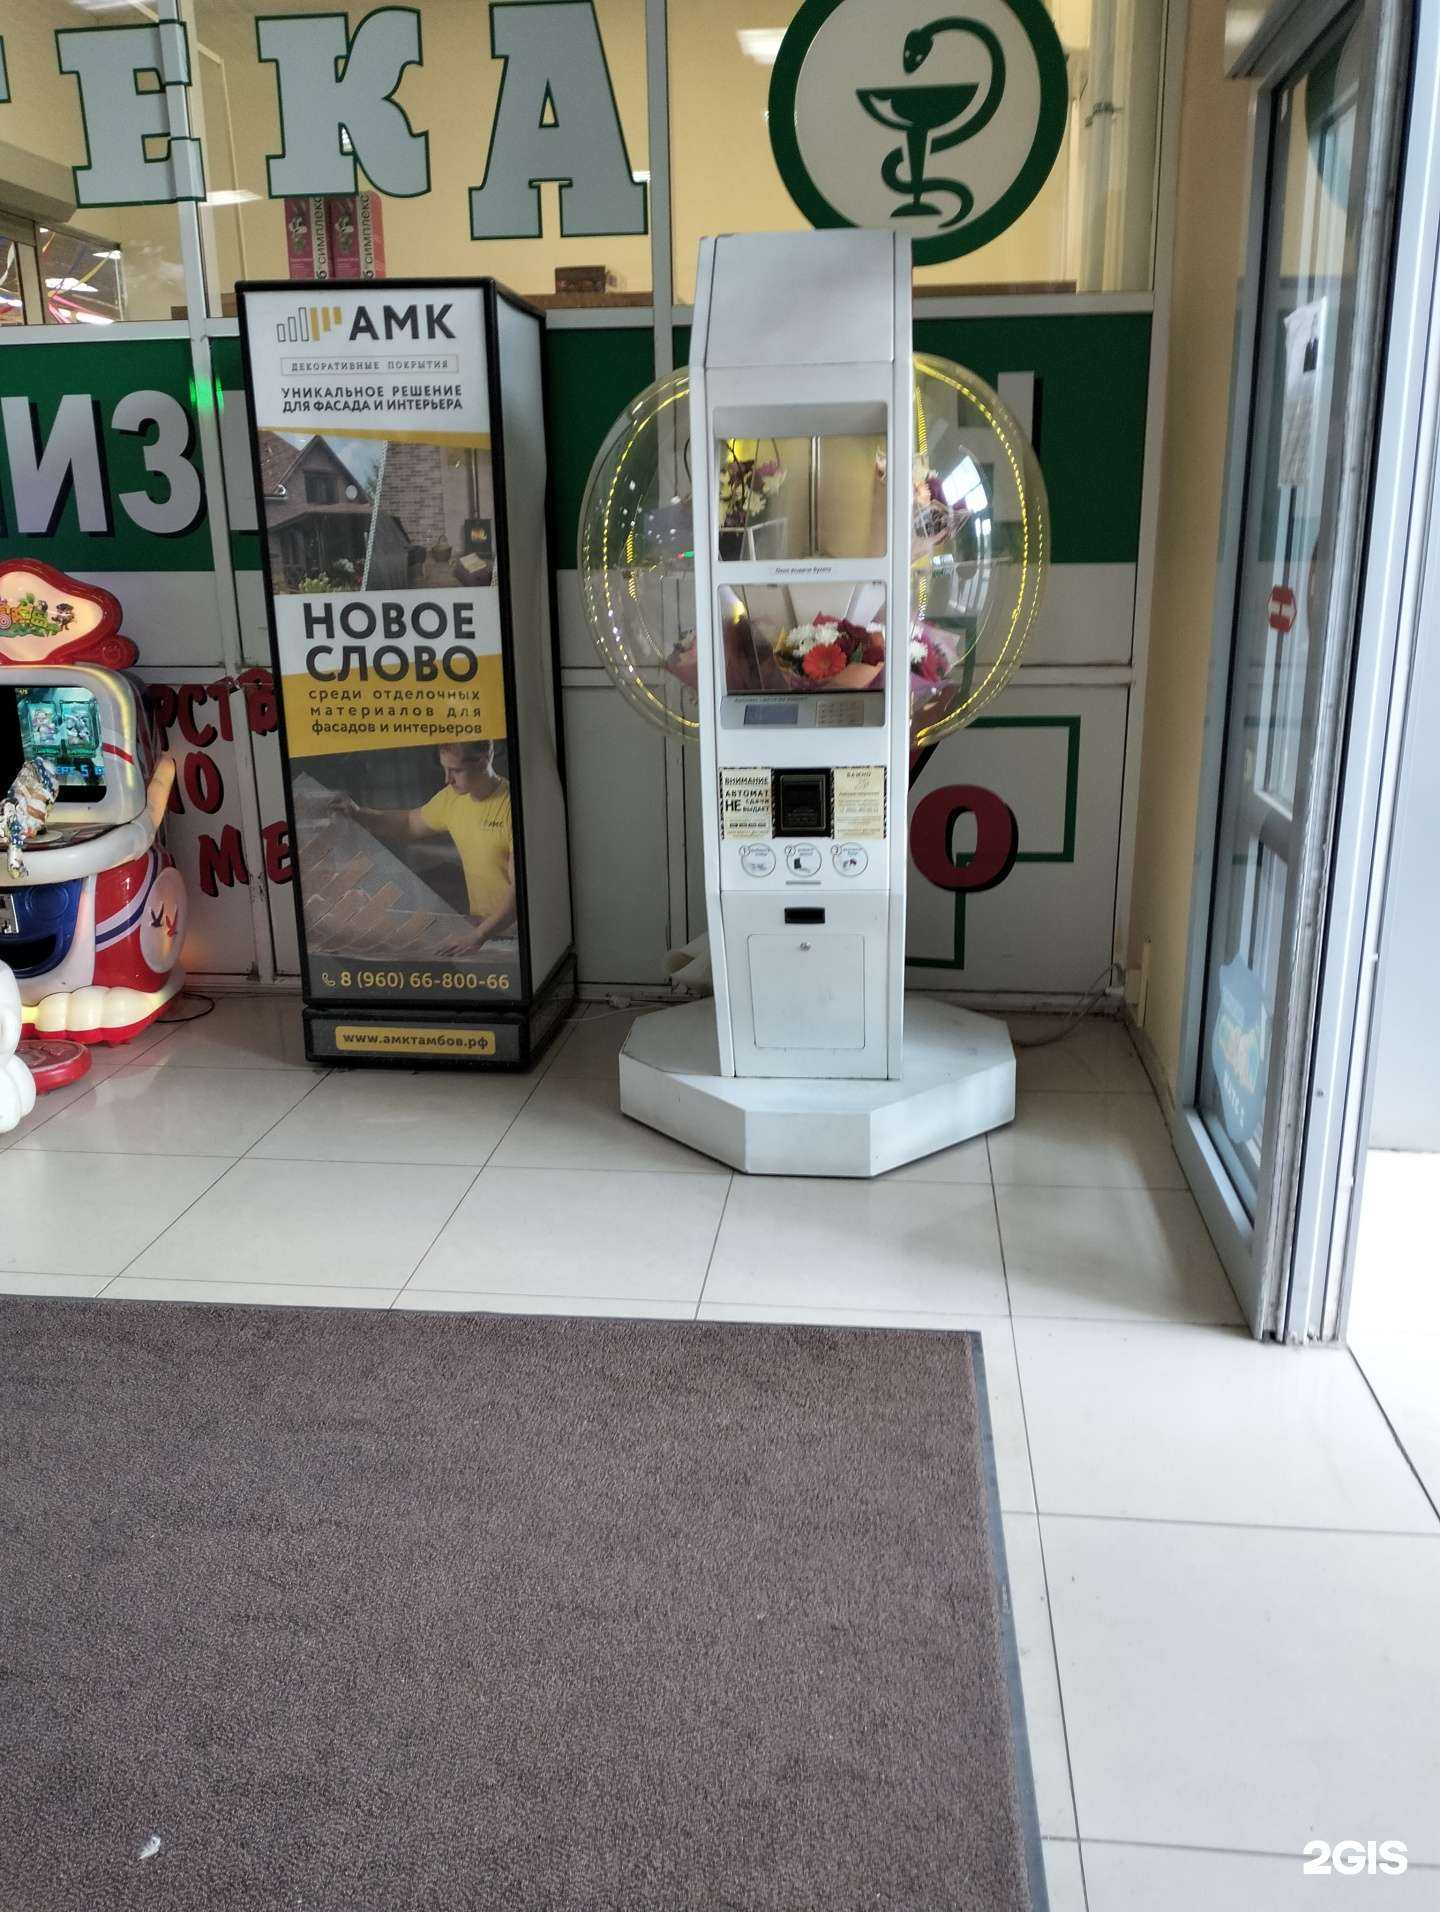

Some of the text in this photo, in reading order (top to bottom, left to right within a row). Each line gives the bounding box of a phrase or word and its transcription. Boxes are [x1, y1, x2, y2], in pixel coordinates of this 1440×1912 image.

[0, 0, 648, 240] ЕКА
[349, 304, 456, 341] АМК
[291, 360, 449, 371] ДЕКОРАТИВНЫЕ ПОКРЫТИЯ
[281, 385, 462, 399] УНИКАЛЬНОЕ РЕШЕНИЕ
[282, 398, 464, 413] ДЛЯ ФАСАДА И ИНТЕРЬЕРА
[303, 601, 476, 640] НОВОЕ
[306, 645, 479, 682] СЛОВО
[308, 688, 480, 702] среди отделочных
[310, 706, 481, 719] материалов для
[312, 720, 482, 736] фасадов и интерьеров
[725, 789, 769, 798] АВТОМАТ
[725, 799, 742, 812] НЕ
[340, 971, 510, 989] 8 (960) 66-800-66
[343, 1033, 488, 1049] www.амктамбов.рф
